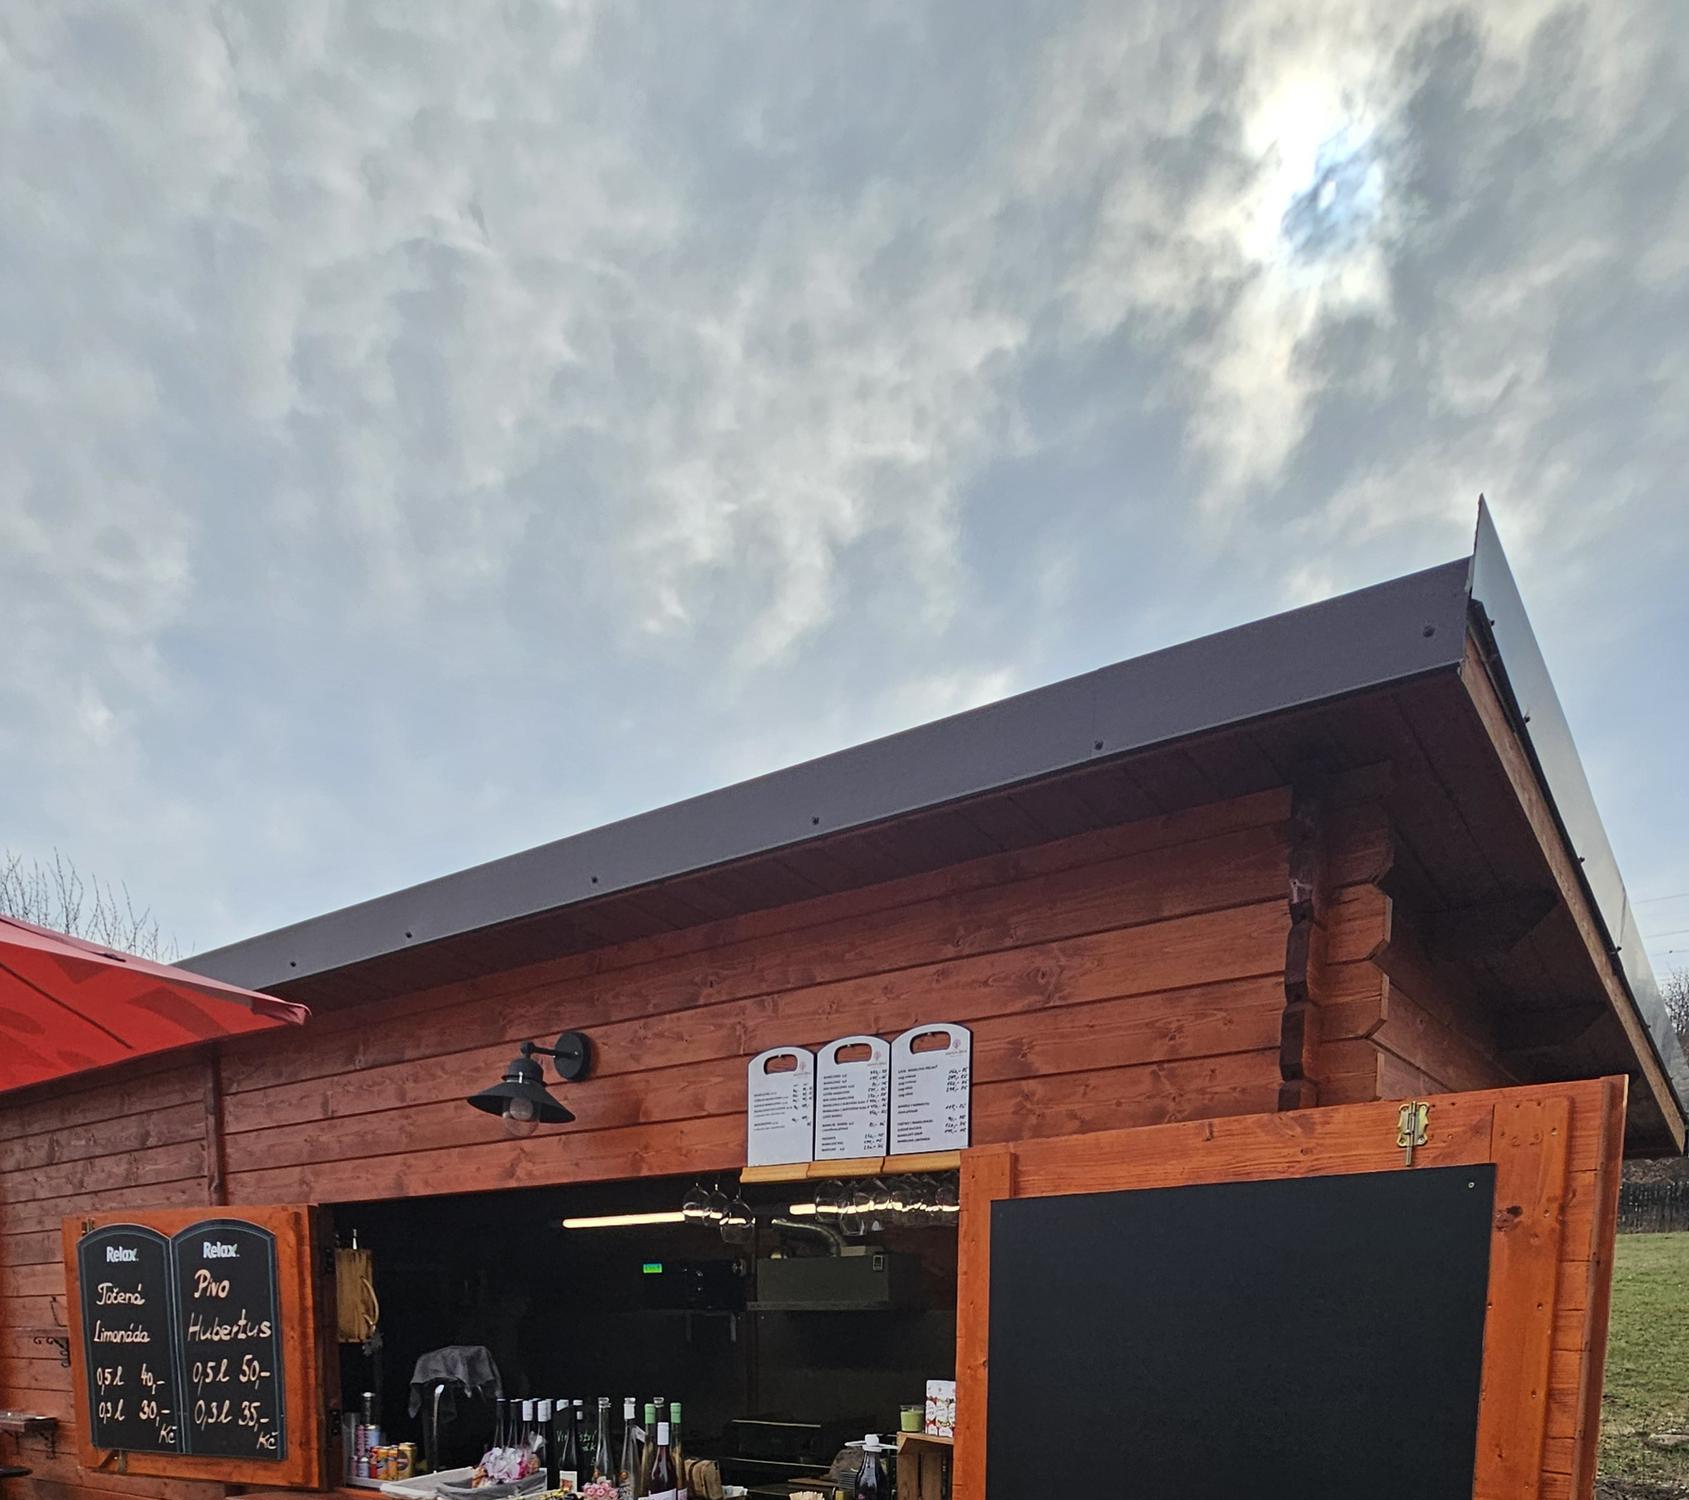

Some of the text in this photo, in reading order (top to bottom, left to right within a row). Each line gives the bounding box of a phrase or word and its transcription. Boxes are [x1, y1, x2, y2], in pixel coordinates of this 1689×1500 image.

[106, 1245, 139, 1263] Relax
[202, 1241, 239, 1259] Relax
[96, 1282, 145, 1305] Točená
[194, 1269, 230, 1299] Pivo
[93, 1320, 150, 1343] Limonáda
[187, 1309, 272, 1341] Hubertus
[158, 1423, 178, 1444] Kč
[257, 1432, 278, 1449] Kč
